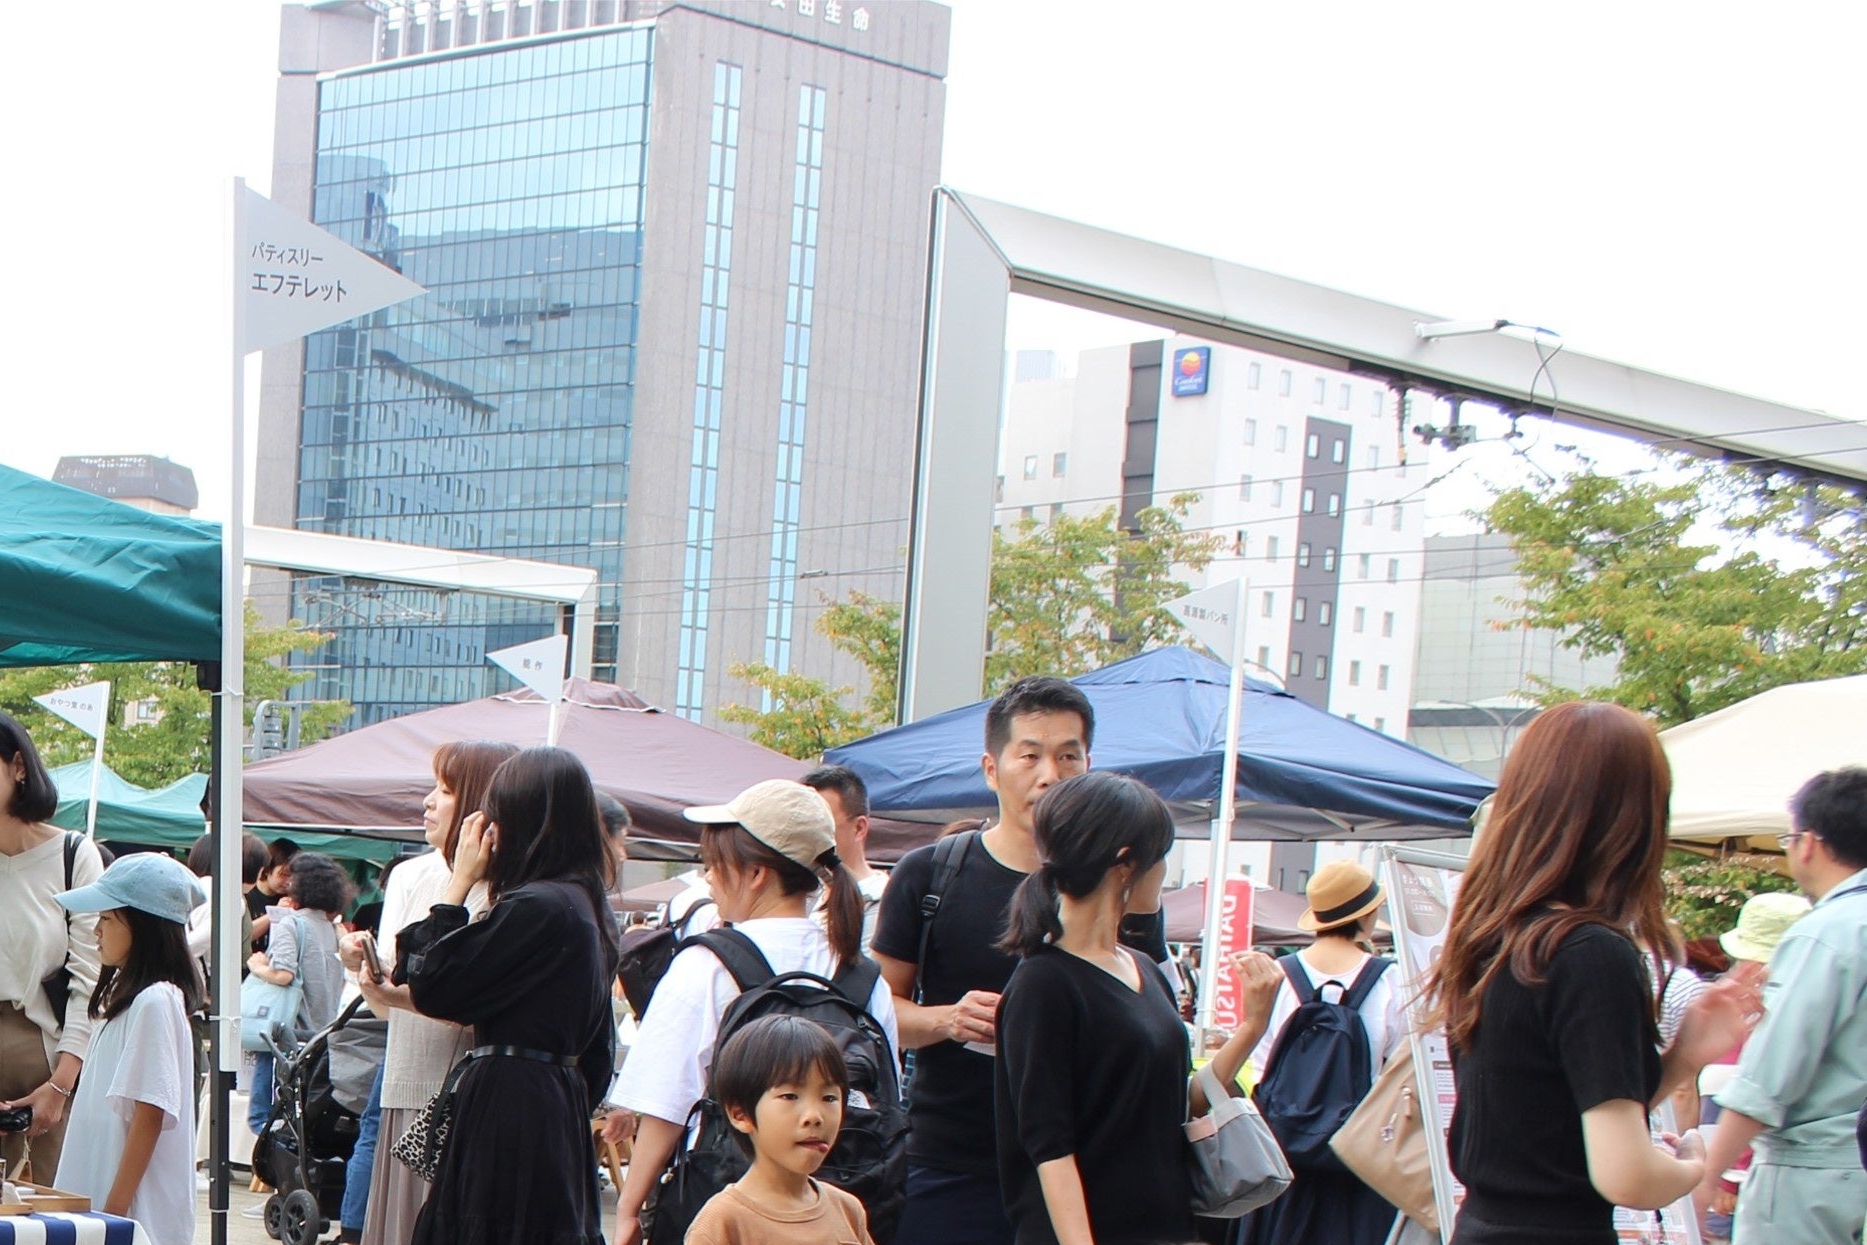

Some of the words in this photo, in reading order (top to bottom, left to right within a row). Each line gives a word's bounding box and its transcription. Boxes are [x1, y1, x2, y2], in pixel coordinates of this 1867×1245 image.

[251, 241, 324, 267] パティスリー
[251, 272, 347, 303] エフテレット
